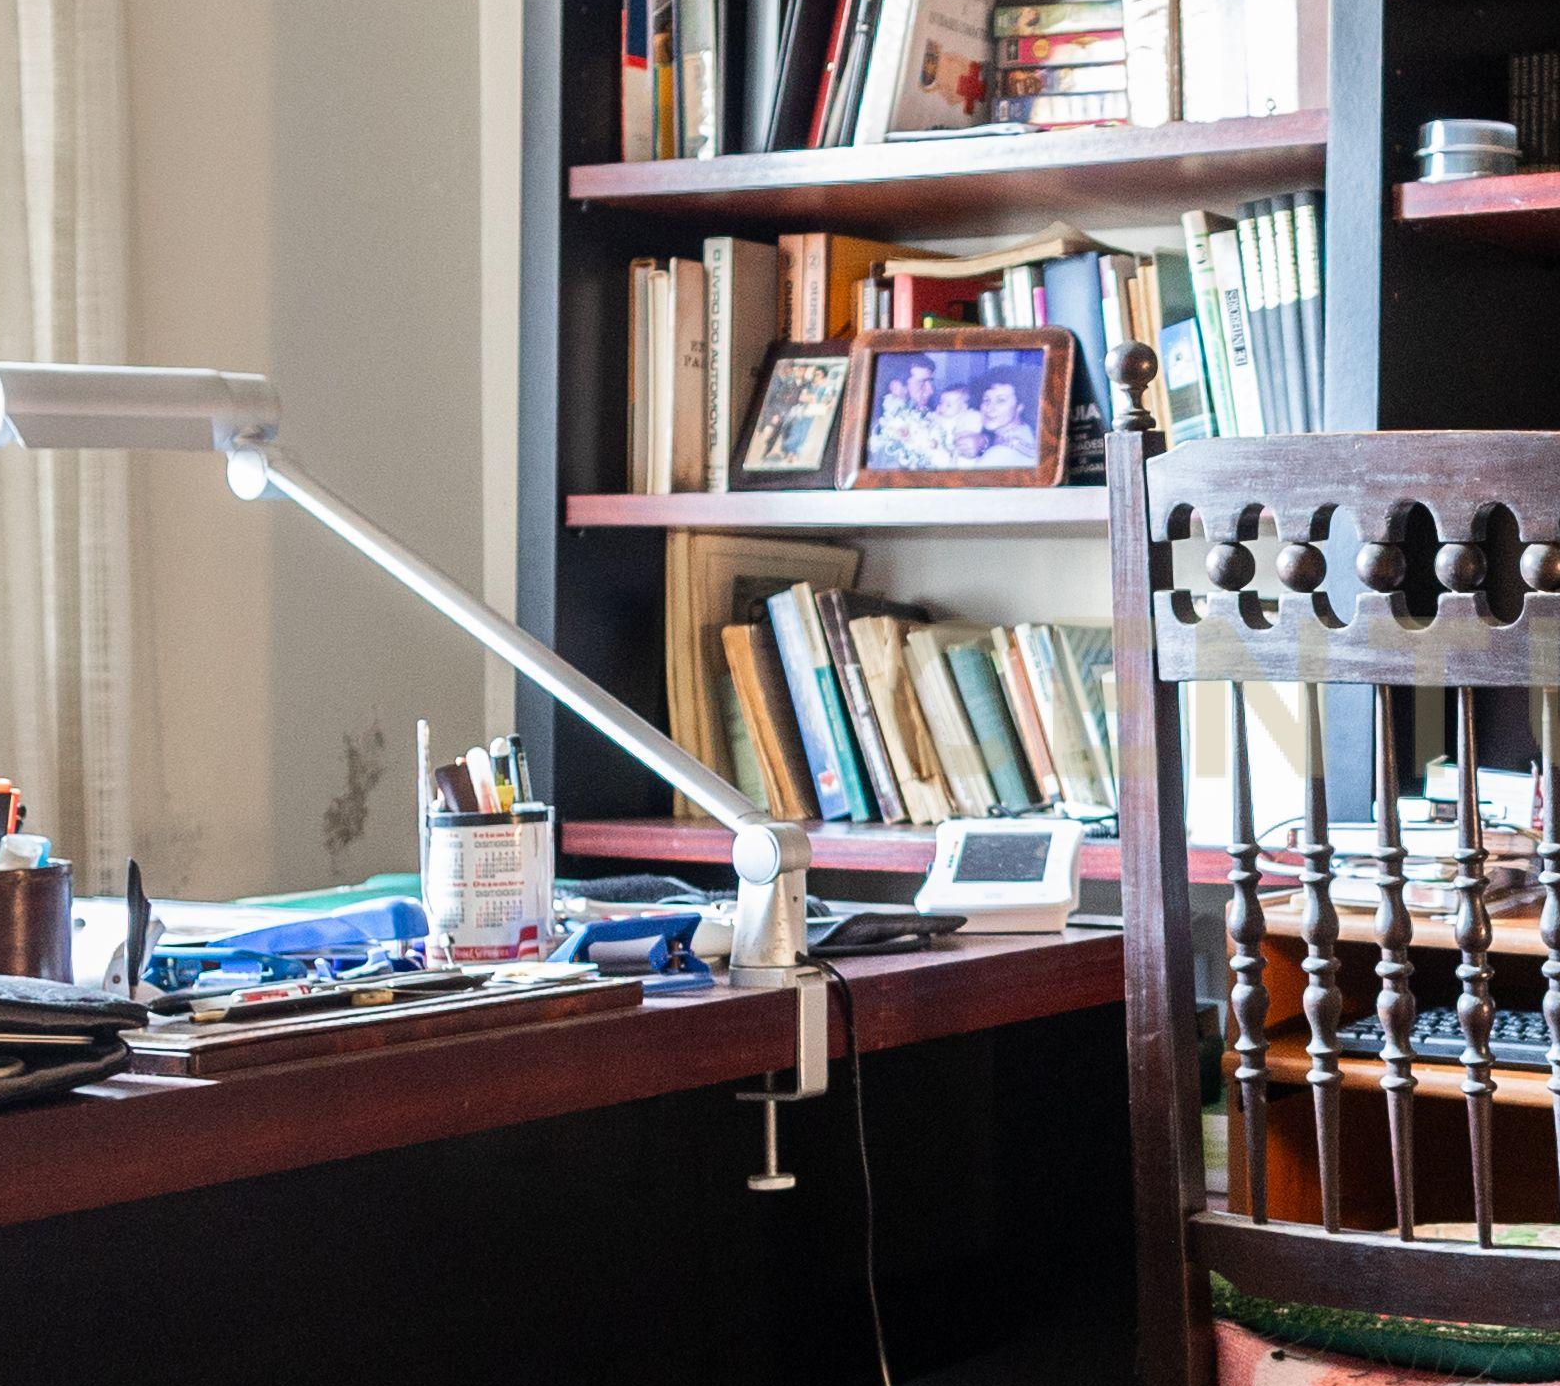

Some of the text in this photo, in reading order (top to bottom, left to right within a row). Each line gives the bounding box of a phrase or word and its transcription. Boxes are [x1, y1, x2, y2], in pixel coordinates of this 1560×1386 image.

[711, 266, 721, 315] LIVRO
[710, 319, 721, 345] DO
[709, 349, 721, 451] AUTOMÓVEL
